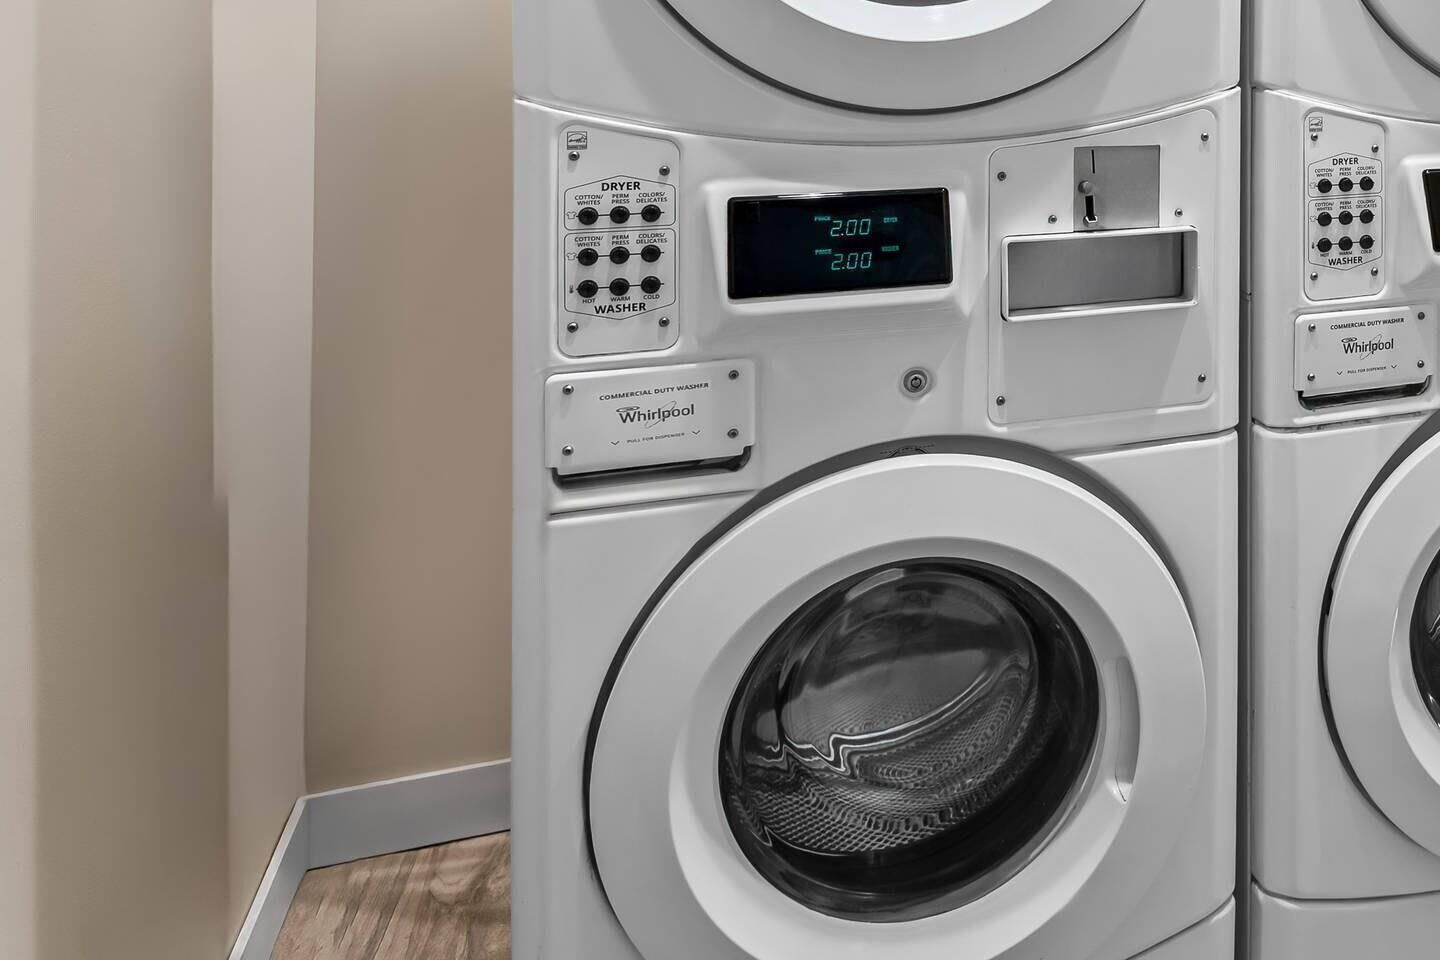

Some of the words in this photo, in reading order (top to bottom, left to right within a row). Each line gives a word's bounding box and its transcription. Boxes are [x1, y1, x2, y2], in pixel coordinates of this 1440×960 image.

[1332, 157, 1359, 166] DRYER
[601, 181, 641, 192] DRYER
[830, 218, 871, 237] 2.00
[831, 252, 873, 271] 2.00
[1328, 256, 1363, 266] WASHER
[594, 302, 646, 314] WASHER
[1330, 322, 1366, 330] COMMERCIAL
[1382, 317, 1405, 325] WASHER
[1343, 338, 1394, 355] Whirlpool
[599, 389, 653, 401] COMMERCIAL
[654, 386, 675, 394] DUTY
[676, 382, 709, 391] WASHER
[618, 403, 695, 424] Whirlpool
